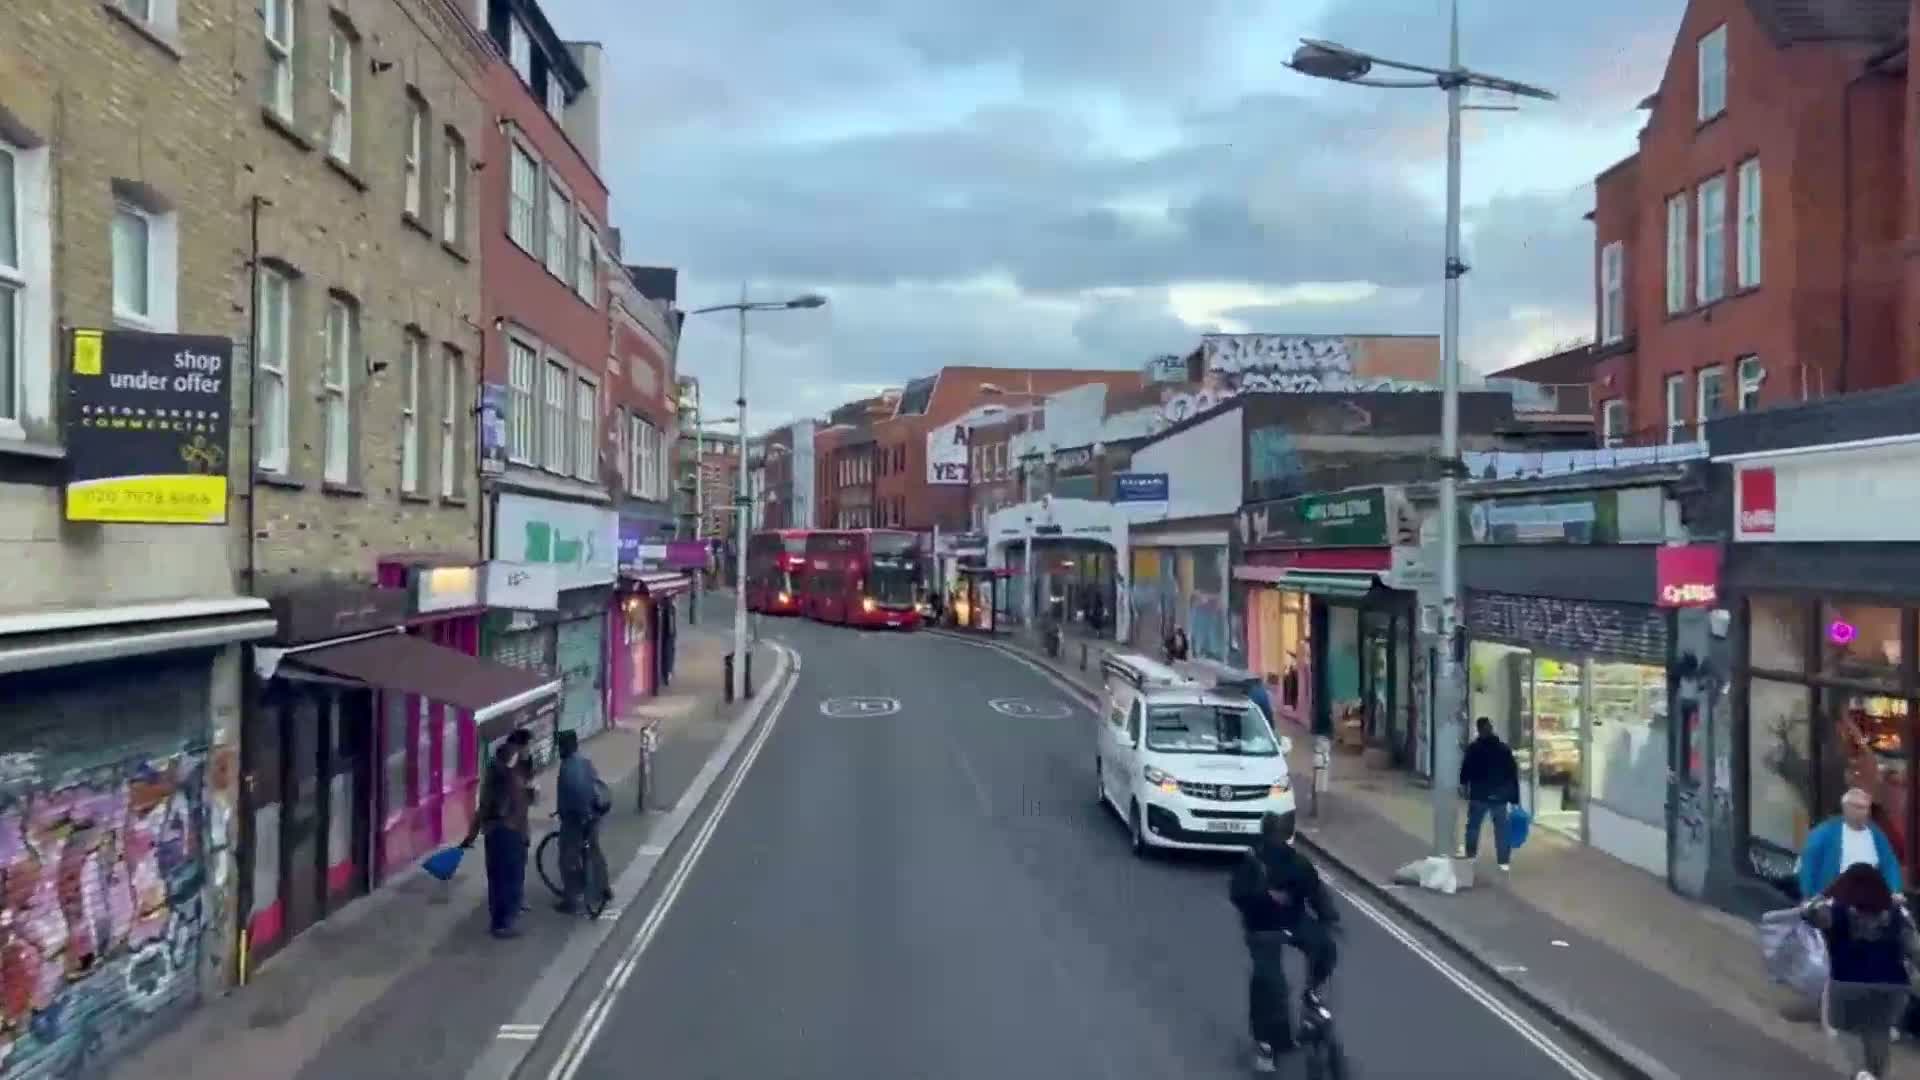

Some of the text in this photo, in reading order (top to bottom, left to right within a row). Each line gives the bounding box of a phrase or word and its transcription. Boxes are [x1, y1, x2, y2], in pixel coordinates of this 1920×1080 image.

[173, 350, 221, 375] shop
[109, 371, 221, 393] under offer
